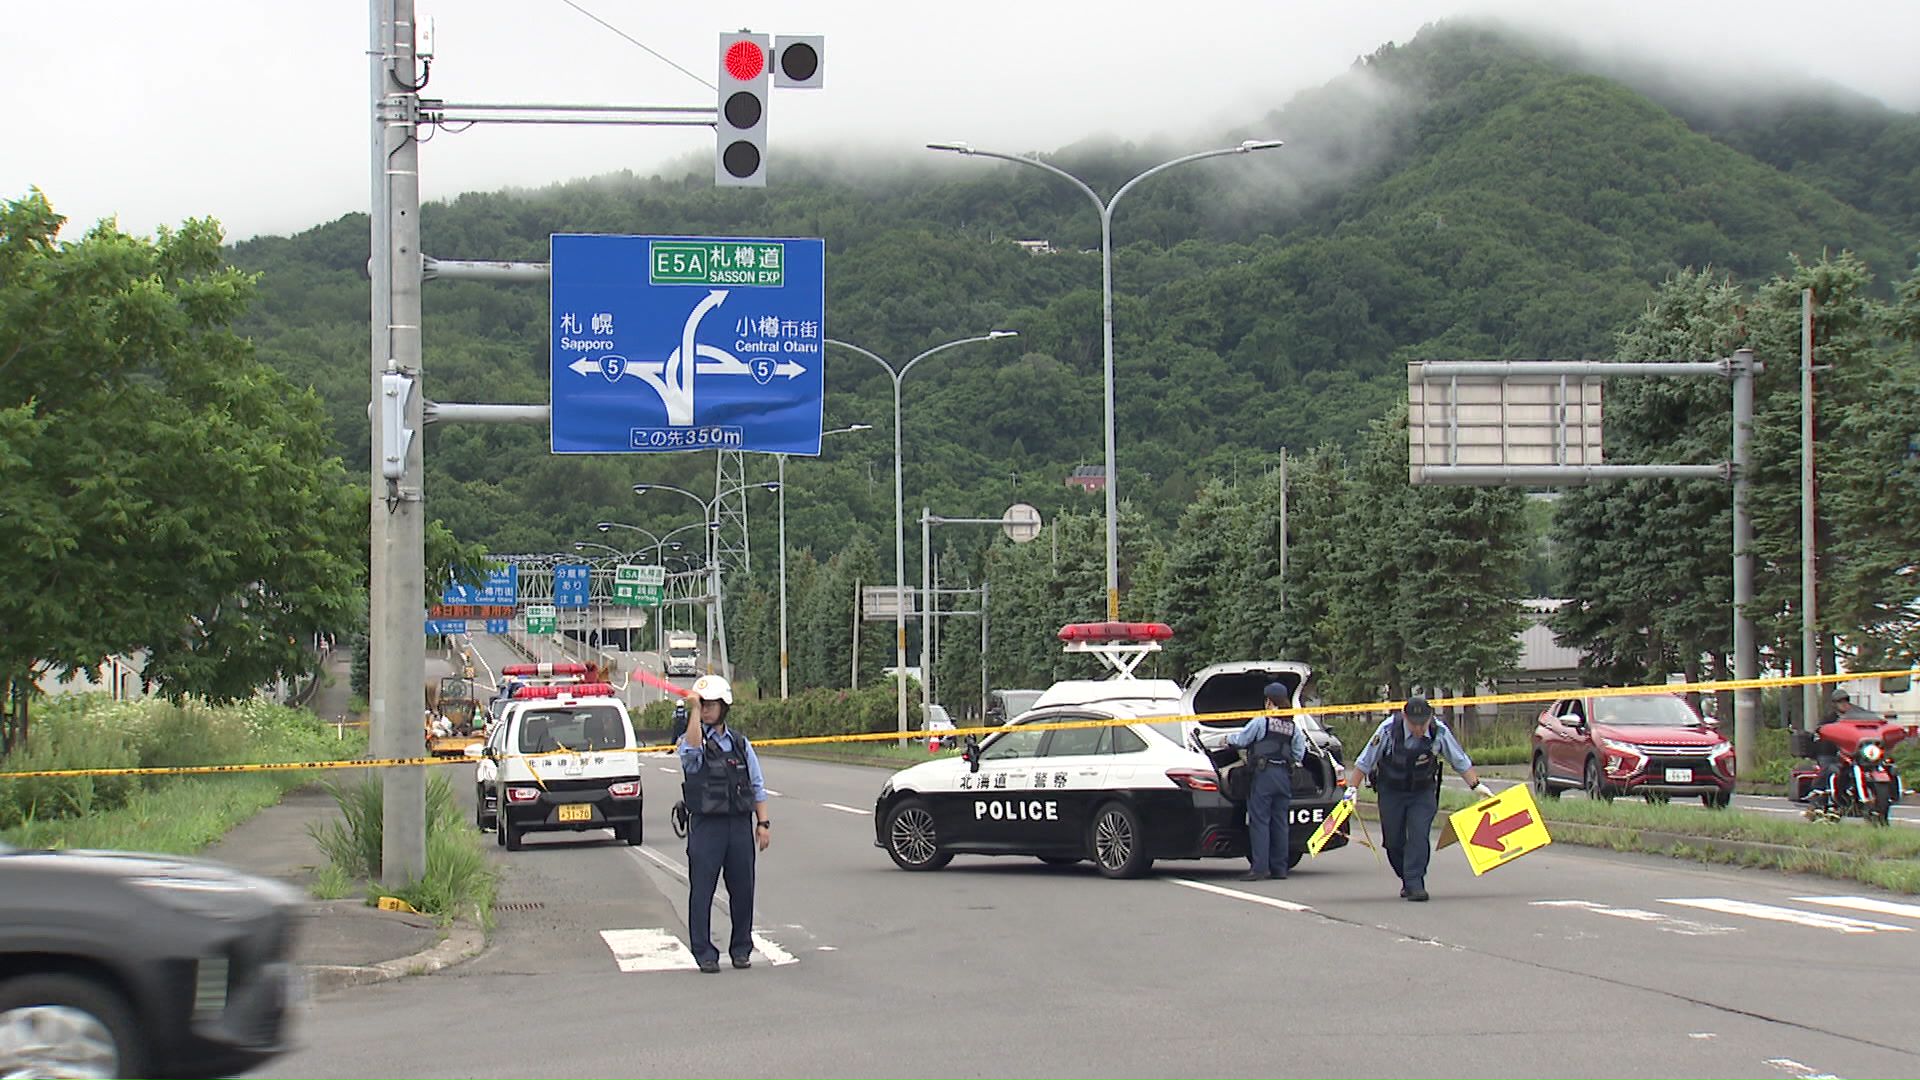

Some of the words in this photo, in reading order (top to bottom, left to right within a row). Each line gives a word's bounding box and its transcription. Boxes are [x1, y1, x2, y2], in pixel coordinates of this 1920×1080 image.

[656, 252, 703, 273] E5A
[709, 245, 780, 270] 札樽道
[709, 271, 756, 283] SASSON
[758, 271, 780, 283] EXP
[560, 312, 614, 336] 札幌
[735, 315, 818, 339] 小樽市街
[560, 337, 614, 351] Sapporo
[735, 340, 779, 353] Central
[783, 340, 818, 353] Otaru
[607, 359, 618, 374] 5
[757, 362, 769, 377] 5
[634, 427, 741, 447] この先350m
[959, 772, 1007, 790] 北海道
[1034, 771, 1068, 788] 警察
[974, 800, 1059, 821] POLICE
